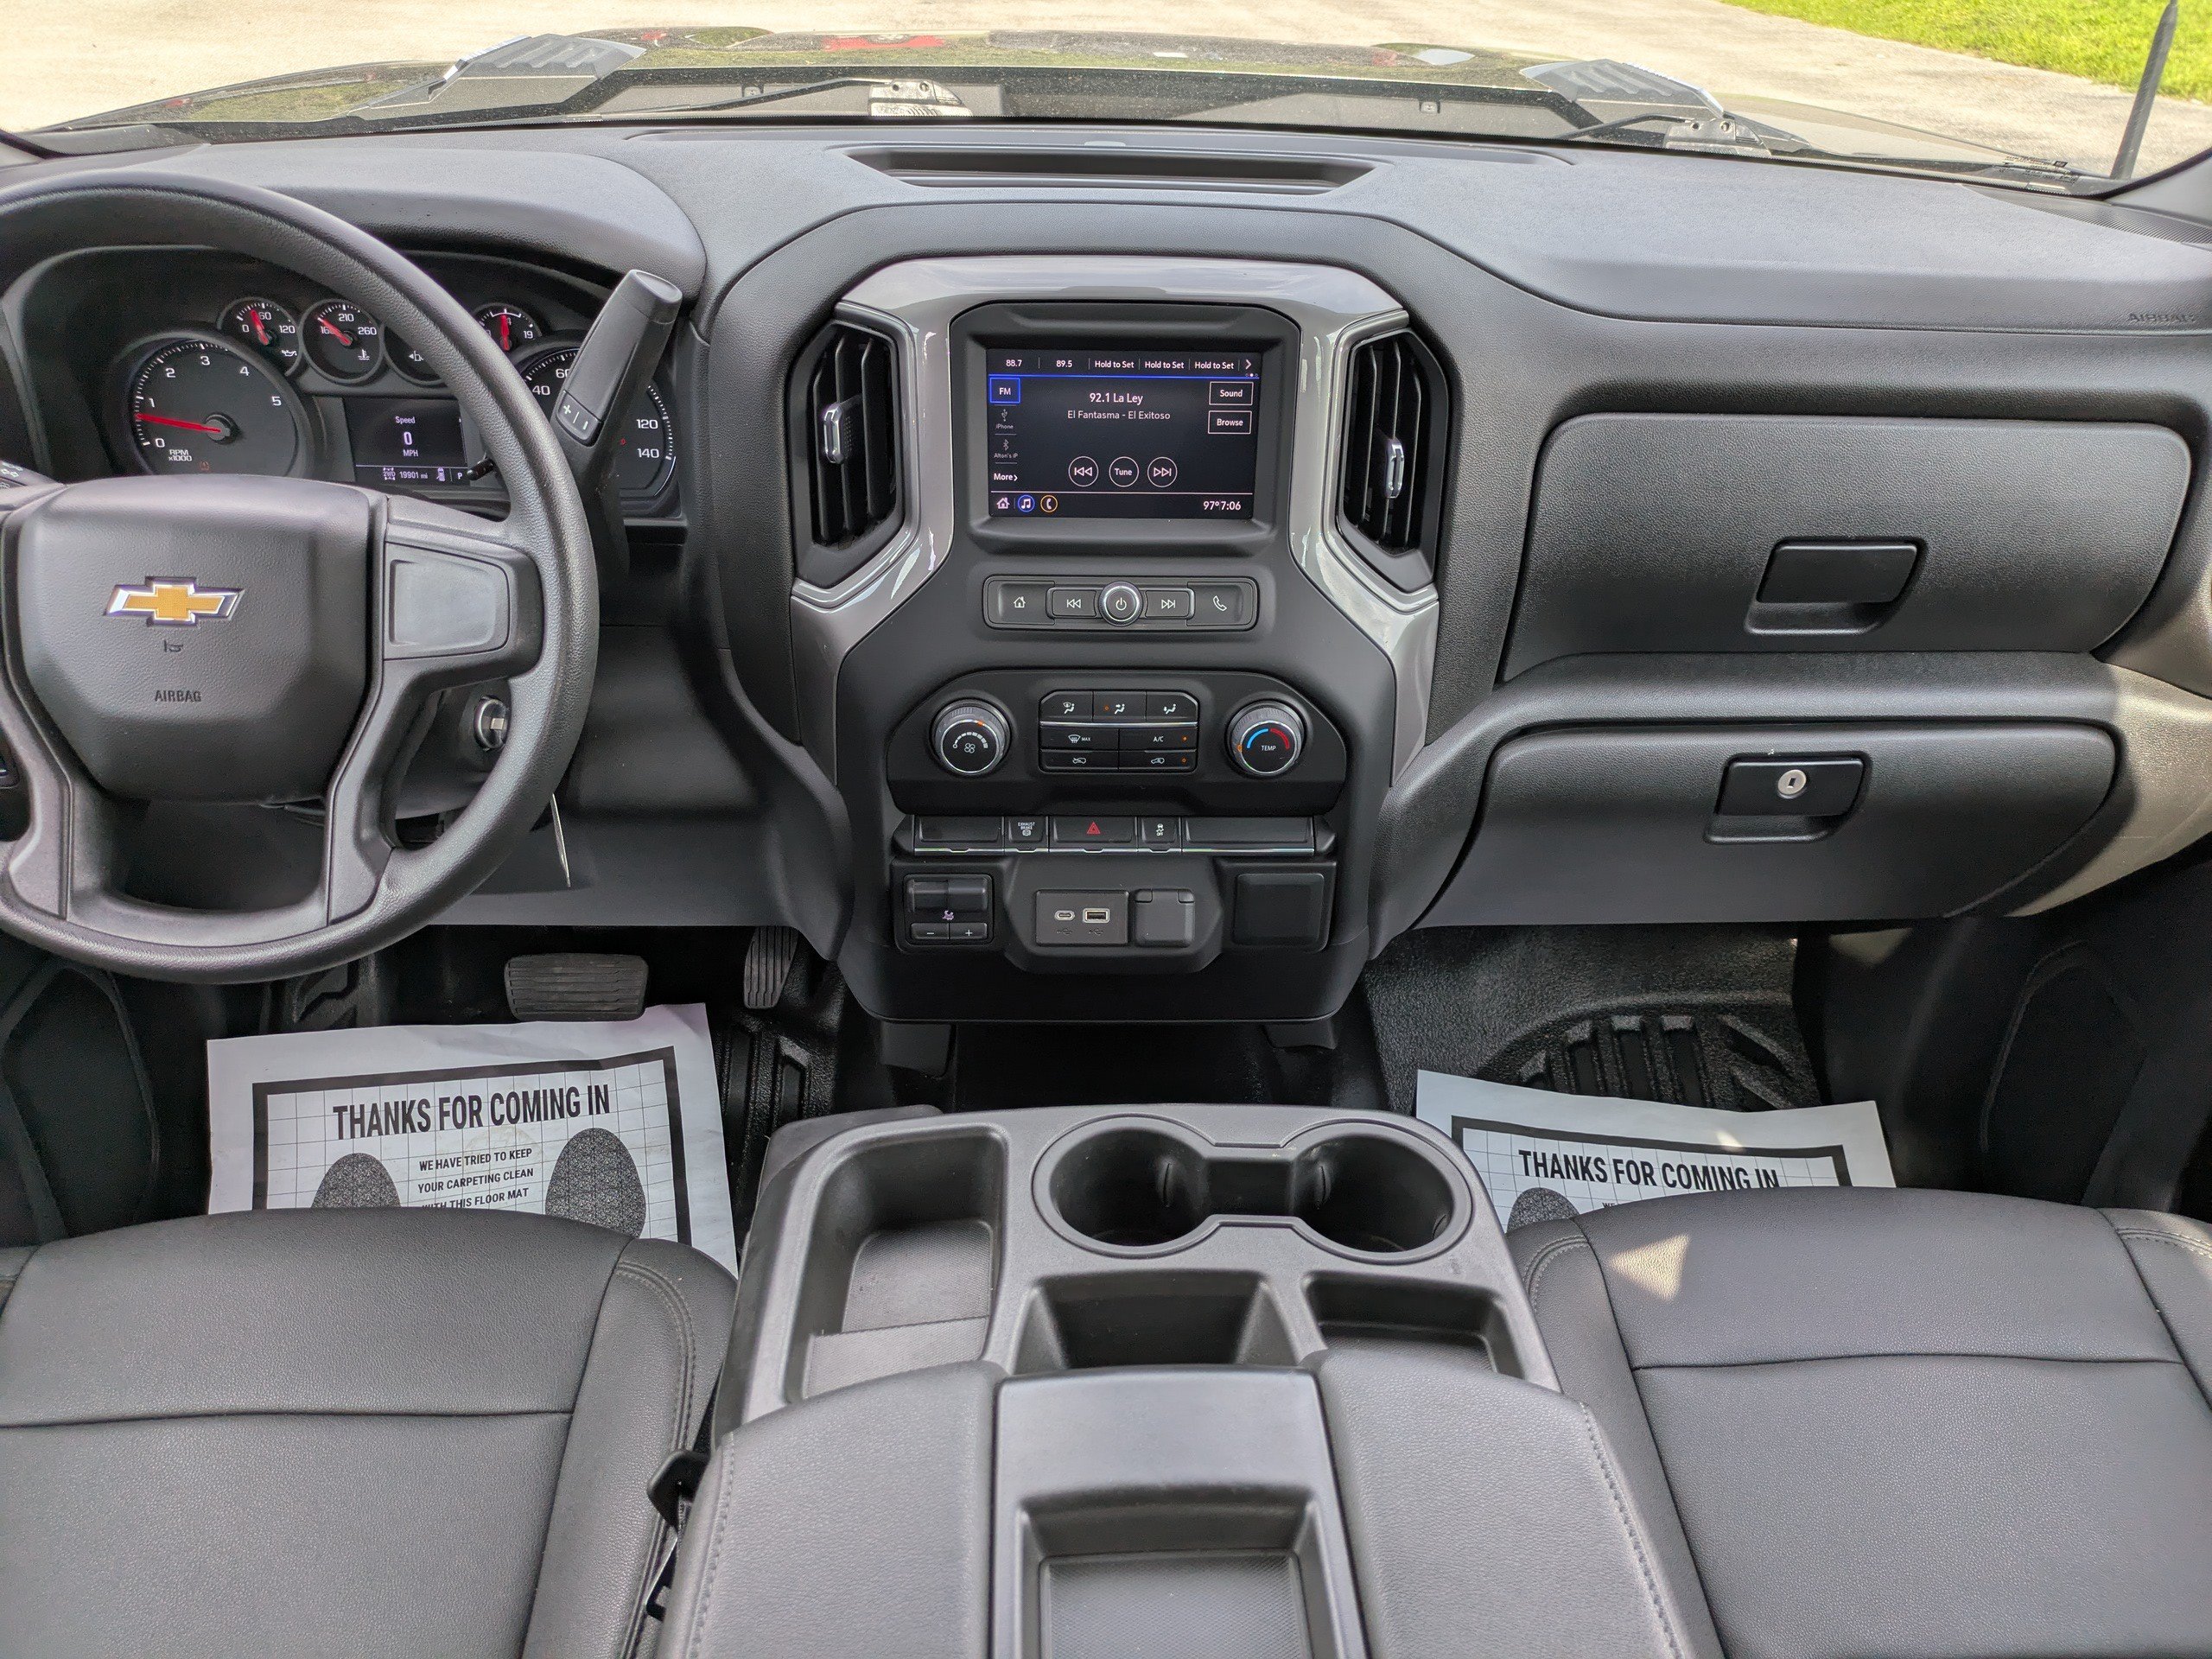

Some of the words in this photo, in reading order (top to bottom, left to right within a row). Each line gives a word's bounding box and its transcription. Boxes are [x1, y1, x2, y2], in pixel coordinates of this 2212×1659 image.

[338, 313, 355, 322] 210
[241, 324, 250, 333] 0
[279, 325, 296, 334] 120
[357, 327, 378, 335] 260
[523, 330, 534, 339] 19
[200, 355, 211, 366] 3
[1005, 359, 1022, 367] 88.7
[1056, 359, 1073, 368] 89.5
[1122, 360, 1135, 369] Set
[165, 367, 176, 378] 2
[239, 365, 250, 377] 4
[531, 385, 551, 396] 40
[999, 387, 1012, 396] FM
[1219, 389, 1243, 397] Sound
[149, 397, 156, 408] 1
[271, 395, 282, 406] 5
[1089, 392, 1110, 403] 92.1
[1113, 392, 1124, 403] La
[1127, 393, 1143, 405] Ley
[395, 416, 416, 424] Speed
[1067, 410, 1076, 419] El
[1077, 410, 1120, 419] Fantasma
[1128, 410, 1136, 420] El
[1138, 410, 1171, 420] Exitoso
[637, 419, 658, 429] 120
[1216, 418, 1244, 427] Browse
[155, 437, 166, 448] 0
[403, 431, 413, 446] 0
[637, 448, 660, 459] 140
[1114, 467, 1133, 476] Tune
[994, 473, 1014, 481] More
[154, 690, 202, 703] AIRBAG
[333, 1097, 431, 1140] THANKS
[438, 1094, 483, 1131] FOR
[490, 1086, 581, 1127] COMING
[587, 1084, 610, 1116] IN
[419, 1160, 434, 1171] WE
[435, 1156, 462, 1170] HAVE
[464, 1154, 492, 1166] TRIED
[493, 1151, 506, 1161] TO
[509, 1147, 532, 1160] KEEP
[1518, 1149, 1608, 1183] THANKS
[1612, 1158, 1657, 1186] FOR
[1662, 1162, 1752, 1191] COMING
[1754, 1168, 1780, 1189] IN
[418, 1180, 444, 1193] YOUR
[446, 1173, 501, 1190] CARPETING
[503, 1167, 534, 1181] CLEAN
[448, 1198, 473, 1208] THIS
[474, 1192, 505, 1205] FLOOR
[507, 1187, 530, 1200] MAT
